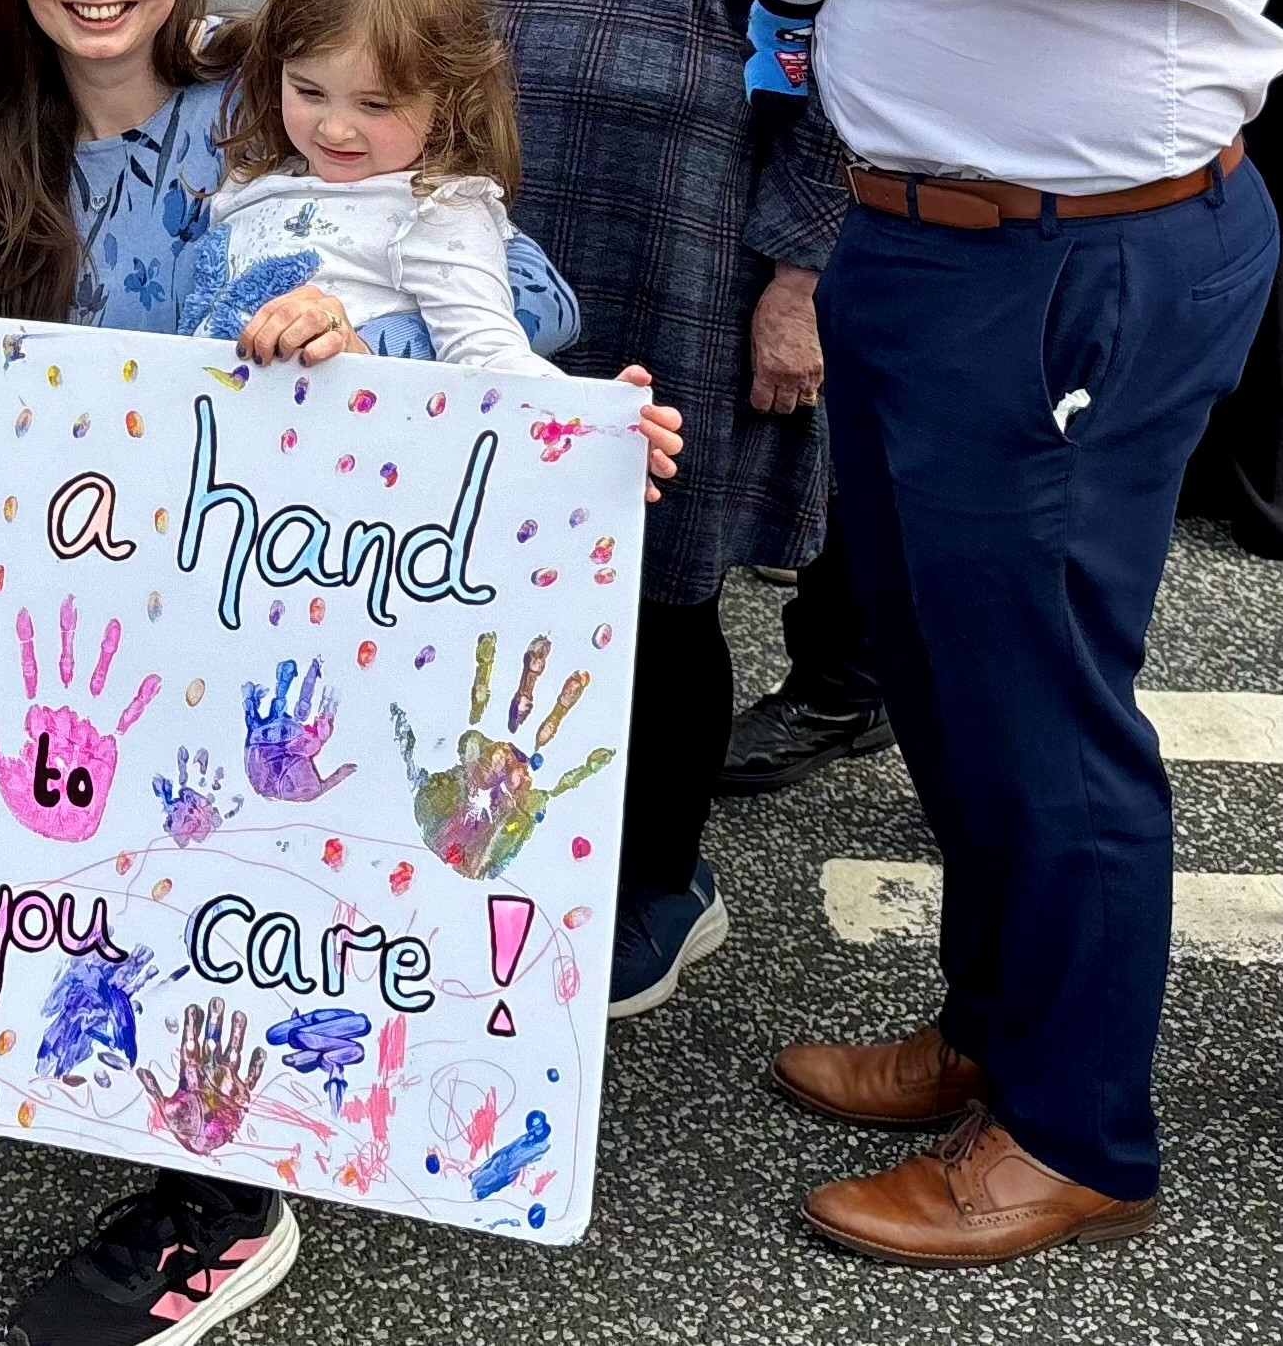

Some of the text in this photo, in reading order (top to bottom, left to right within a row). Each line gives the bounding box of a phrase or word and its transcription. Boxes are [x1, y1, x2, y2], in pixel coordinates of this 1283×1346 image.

[47, 472, 136, 559] a
[177, 394, 499, 631] hand
[33, 732, 94, 807] to
